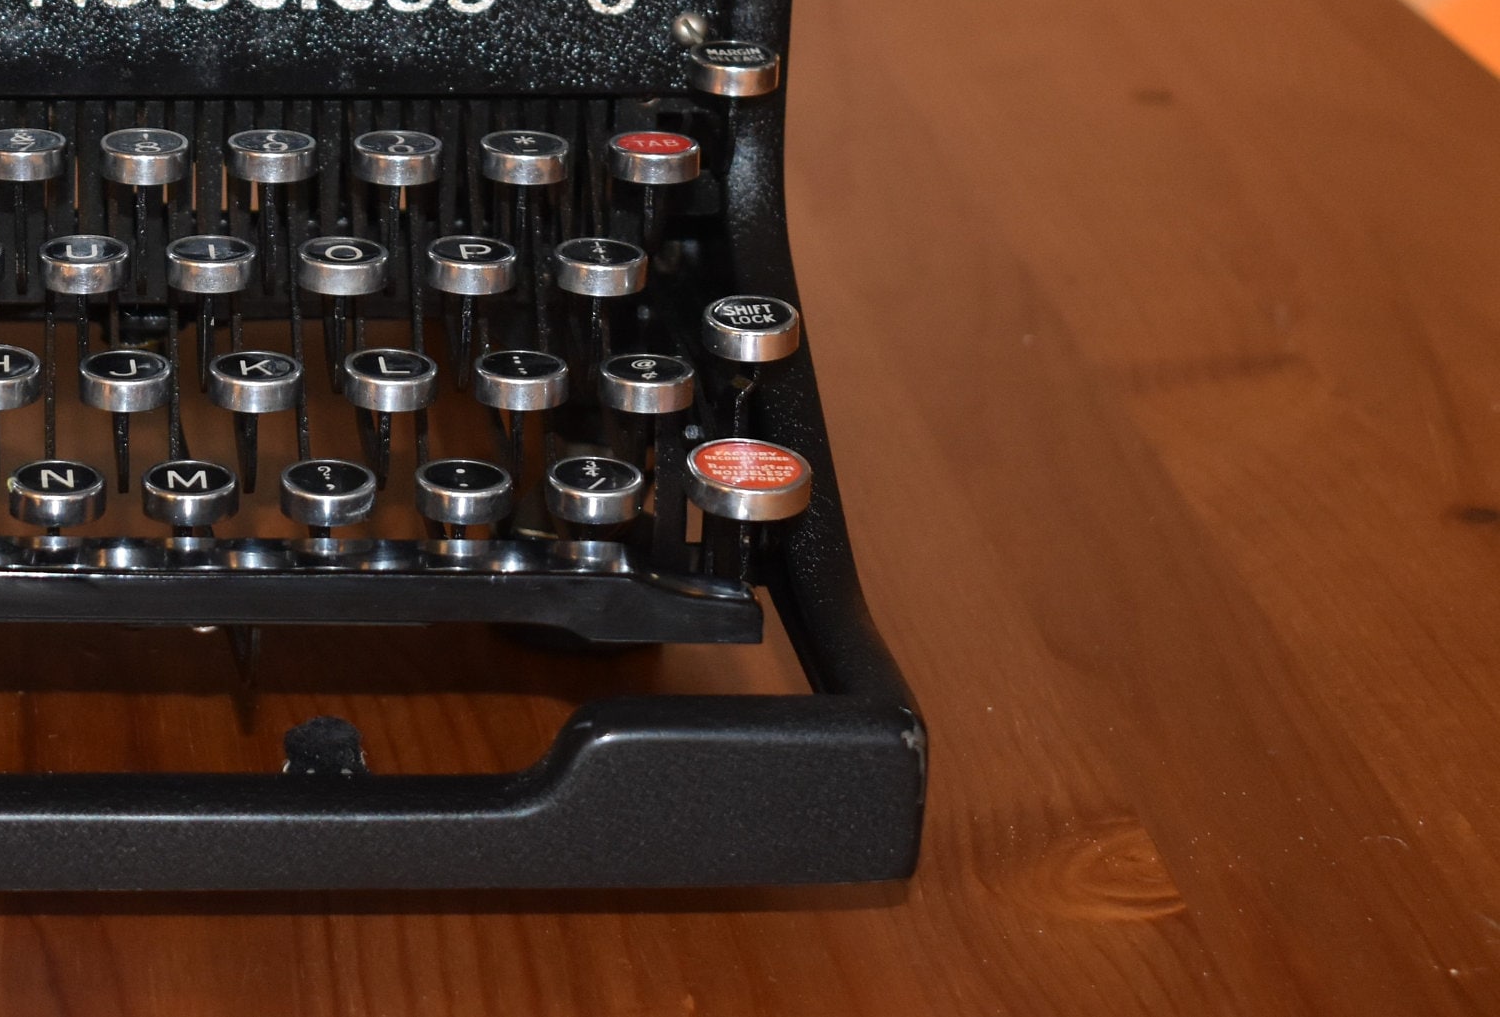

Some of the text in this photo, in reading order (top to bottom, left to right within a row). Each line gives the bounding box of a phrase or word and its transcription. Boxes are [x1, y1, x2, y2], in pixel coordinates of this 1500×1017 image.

[706, 47, 762, 57] MARGIN
[635, 138, 680, 148] TAB
[65, 244, 99, 260] U
[324, 245, 363, 261] O
[458, 243, 492, 260] P
[722, 303, 772, 316] SHIFT
[730, 313, 777, 325] LOCK
[108, 358, 137, 376] J
[239, 358, 271, 376] K
[377, 355, 411, 374] L
[707, 462, 795, 473] Remington
[711, 469, 792, 478] NOISELESS
[40, 468, 75, 490] N
[167, 469, 208, 490] M
